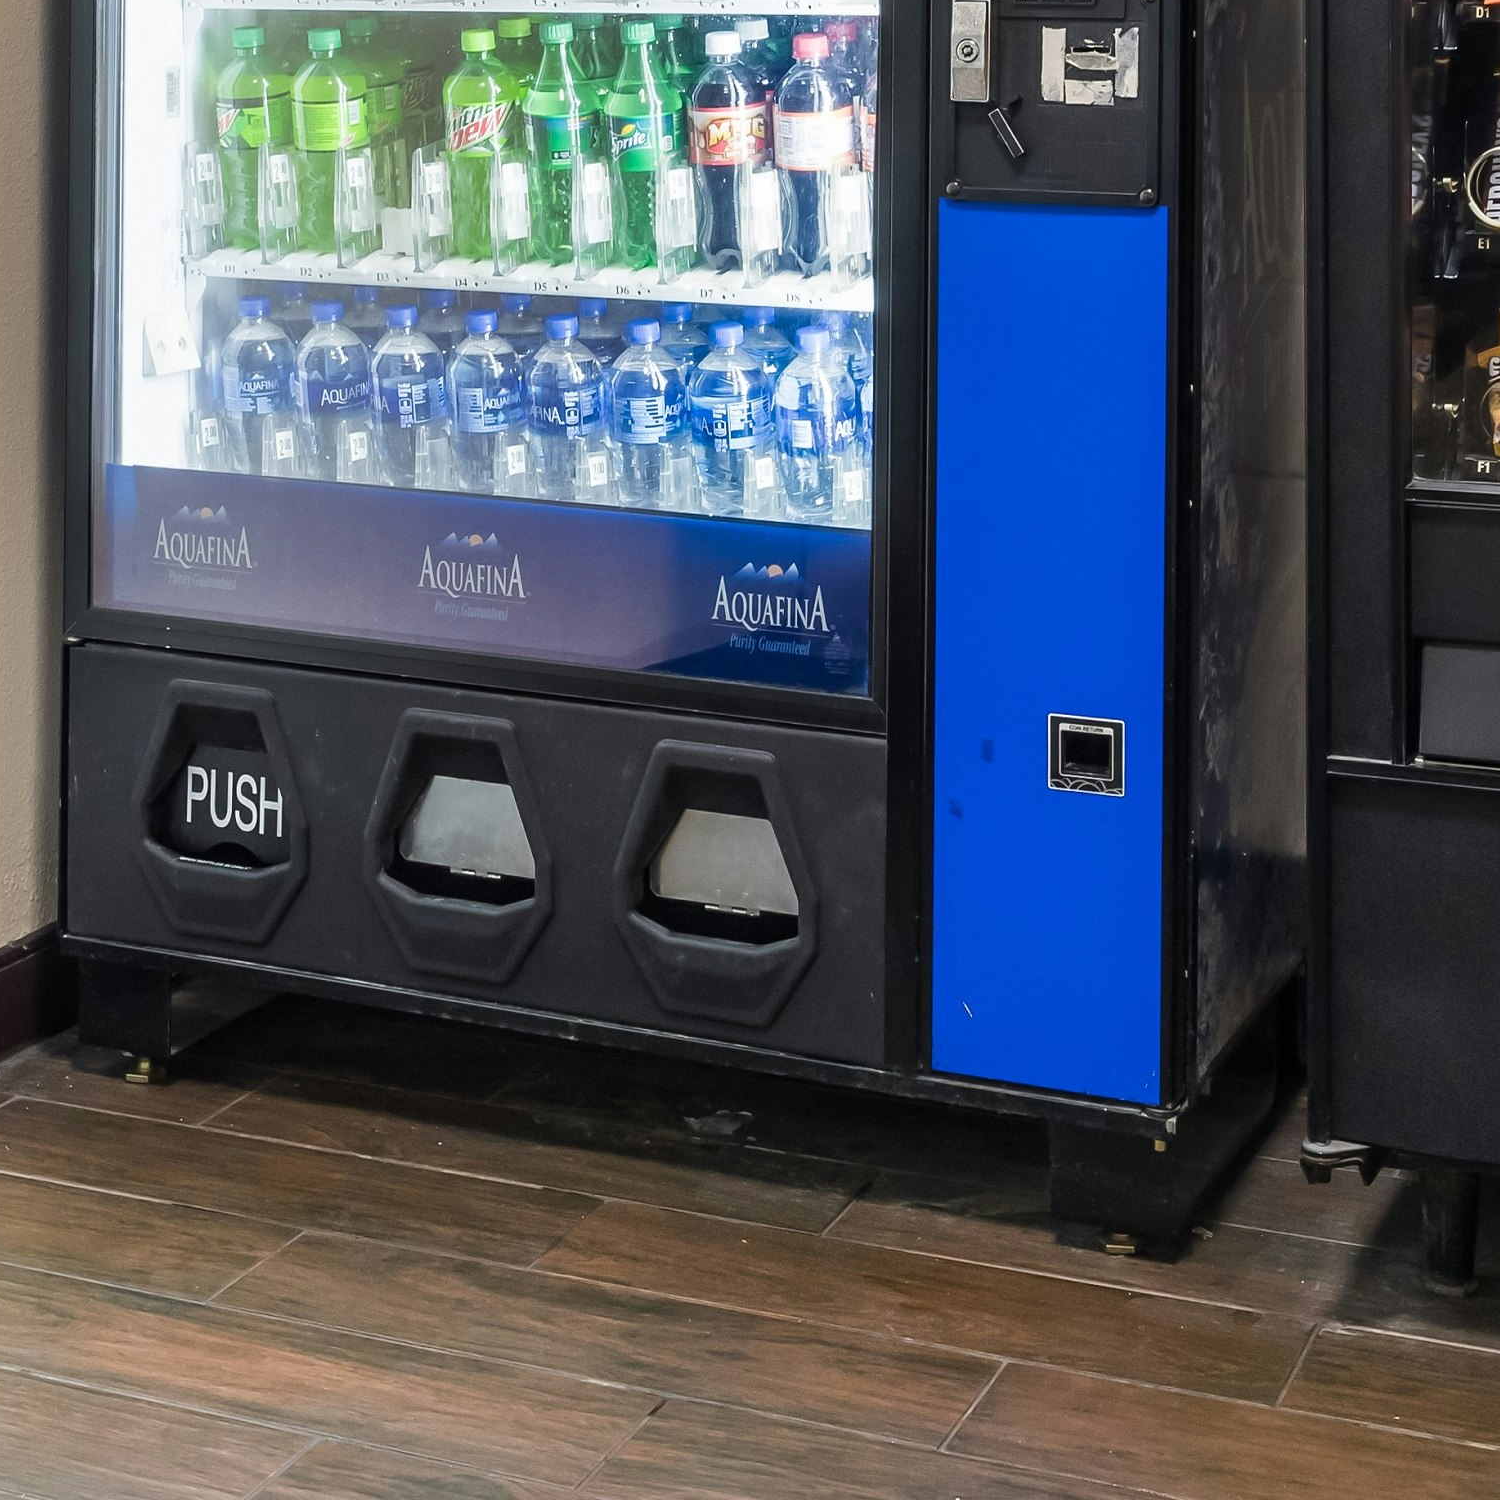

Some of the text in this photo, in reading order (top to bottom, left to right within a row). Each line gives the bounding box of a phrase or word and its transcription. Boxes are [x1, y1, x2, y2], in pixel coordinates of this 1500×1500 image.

[1475, 7, 1489, 19] D1
[612, 132, 647, 154] Sprite
[534, 282, 547, 291] D5
[616, 286, 629, 295] D6
[700, 289, 713, 299] D7
[152, 522, 253, 571] AQUAFINA
[418, 552, 528, 601] AQUAFINA
[711, 584, 830, 632] AQUAFINA
[729, 631, 811, 658] Purity Guaranteed
[186, 766, 284, 838] PUSH
